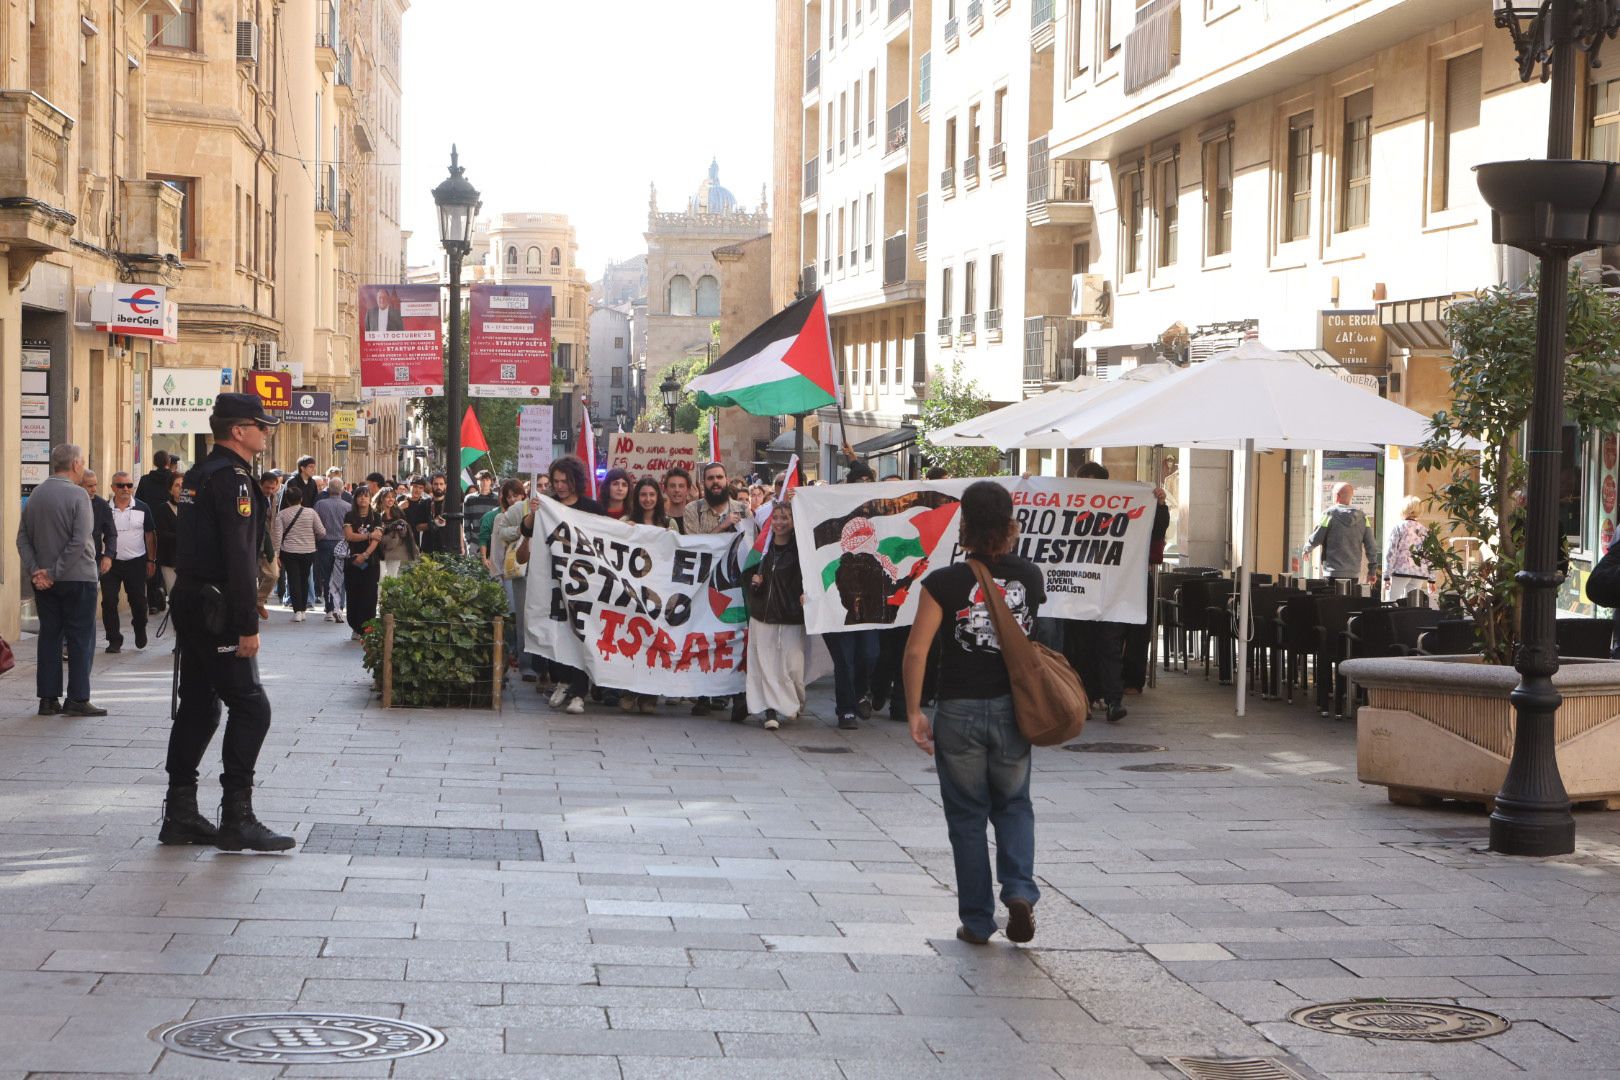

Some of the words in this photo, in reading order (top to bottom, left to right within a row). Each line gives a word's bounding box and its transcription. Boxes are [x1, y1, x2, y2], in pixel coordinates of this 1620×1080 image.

[117, 314, 159, 326] iberCaja
[1328, 315, 1378, 326] COERCIA
[152, 397, 187, 406] NATIVE
[188, 397, 213, 406] CBD
[615, 436, 634, 454] NO
[612, 457, 628, 469] ES
[1009, 491, 1061, 508] ELGA
[1066, 494, 1087, 508] 15
[1090, 494, 1135, 510] OCT
[1015, 508, 1056, 536] RLO
[1061, 509, 1130, 538] TODO
[1011, 537, 1125, 567] LESTINA
[1046, 569, 1101, 580] COORDINADORA
[1046, 577, 1074, 585] JUVENIL
[1046, 585, 1086, 594] SOCIALISTA
